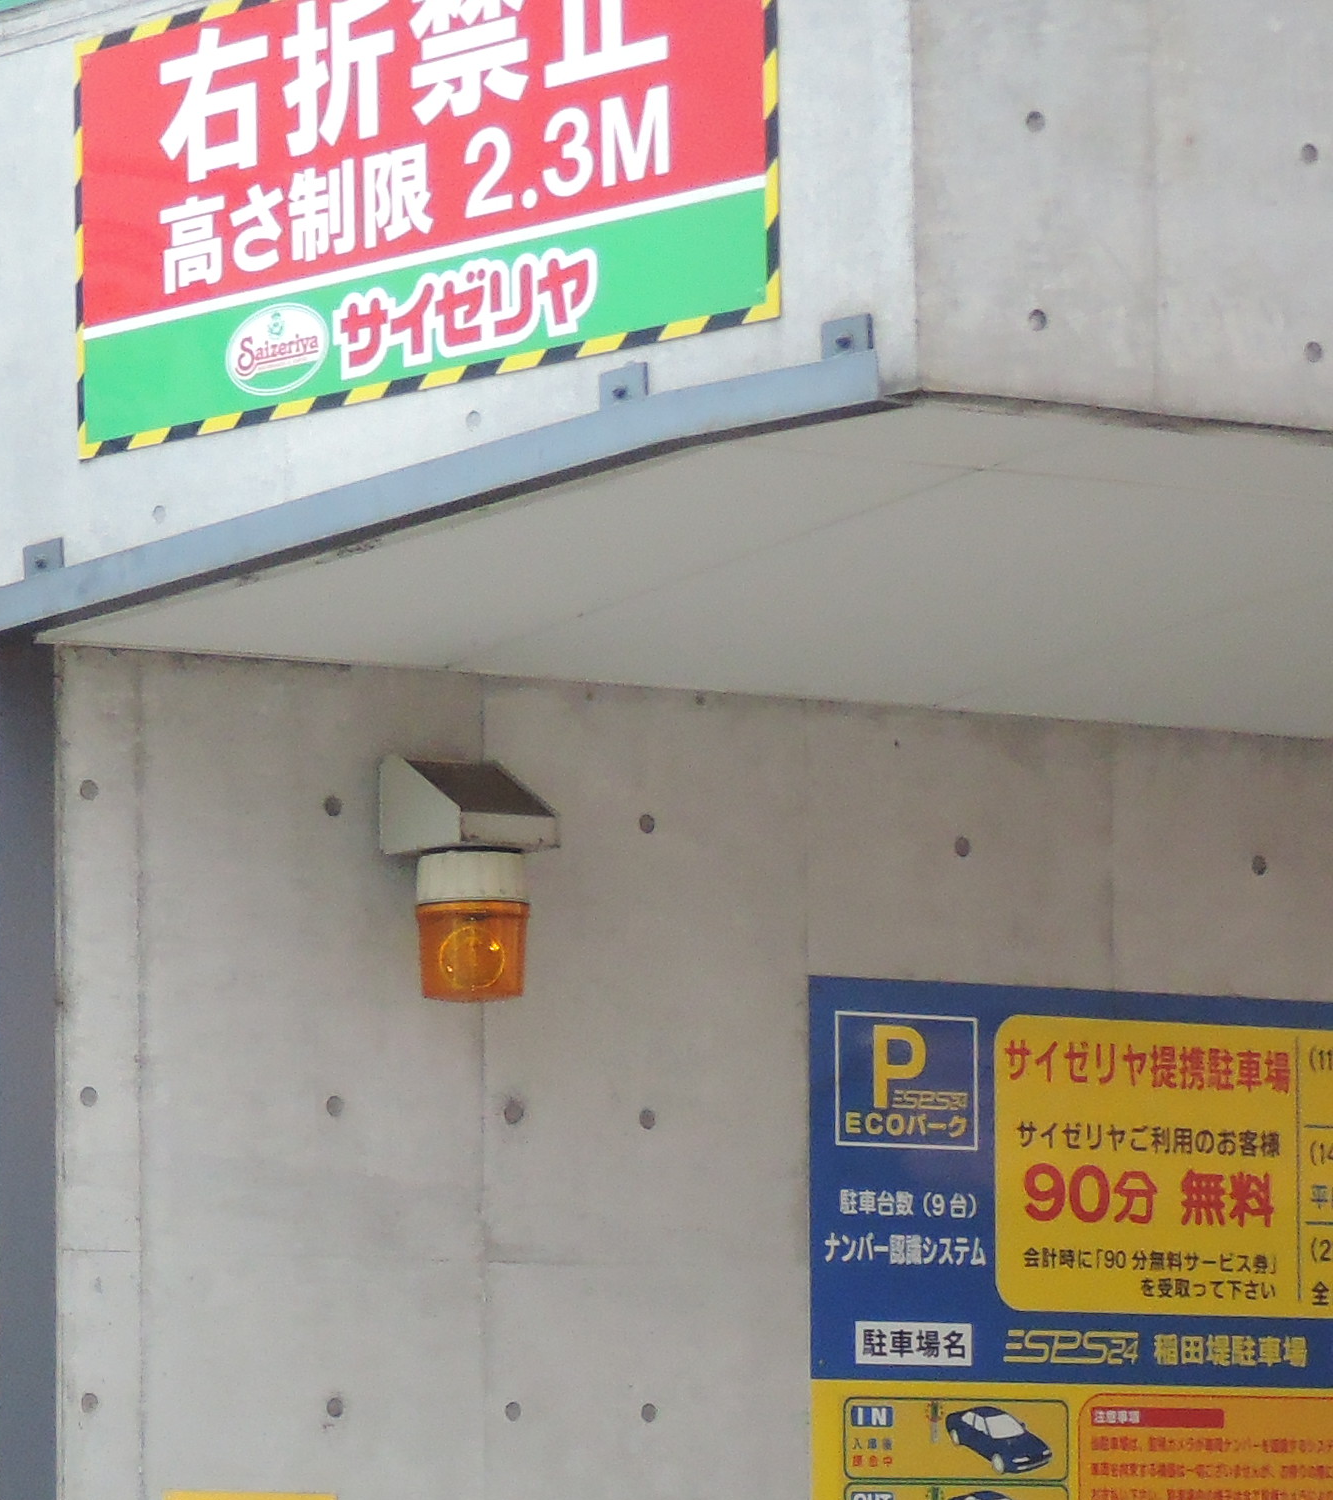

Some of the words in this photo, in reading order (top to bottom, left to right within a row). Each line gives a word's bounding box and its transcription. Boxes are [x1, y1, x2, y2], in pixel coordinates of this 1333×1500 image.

[159, 142, 434, 294] 高さ制限
[463, 84, 670, 219] 2.3M
[339, 257, 591, 370] サイゼリヤ
[234, 334, 319, 378] Saizeriya
[873, 1024, 927, 1108] P
[1005, 1039, 1291, 1094] サイゼリヤ提携駐車場
[845, 1111, 967, 1138] ECOパーク
[1017, 1121, 1280, 1157] サイゼリヤご利用のお客様
[1024, 1163, 1158, 1223] 90分
[1181, 1169, 1274, 1227] 無料
[824, 1232, 986, 1266] ナンバー認識システム
[1140, 1278, 1276, 1300] を受取って下さい
[862, 1328, 966, 1359] 駐車場名
[1153, 1334, 1307, 1368] 稲田堤駐車場
[856, 1406, 887, 1426] IN
